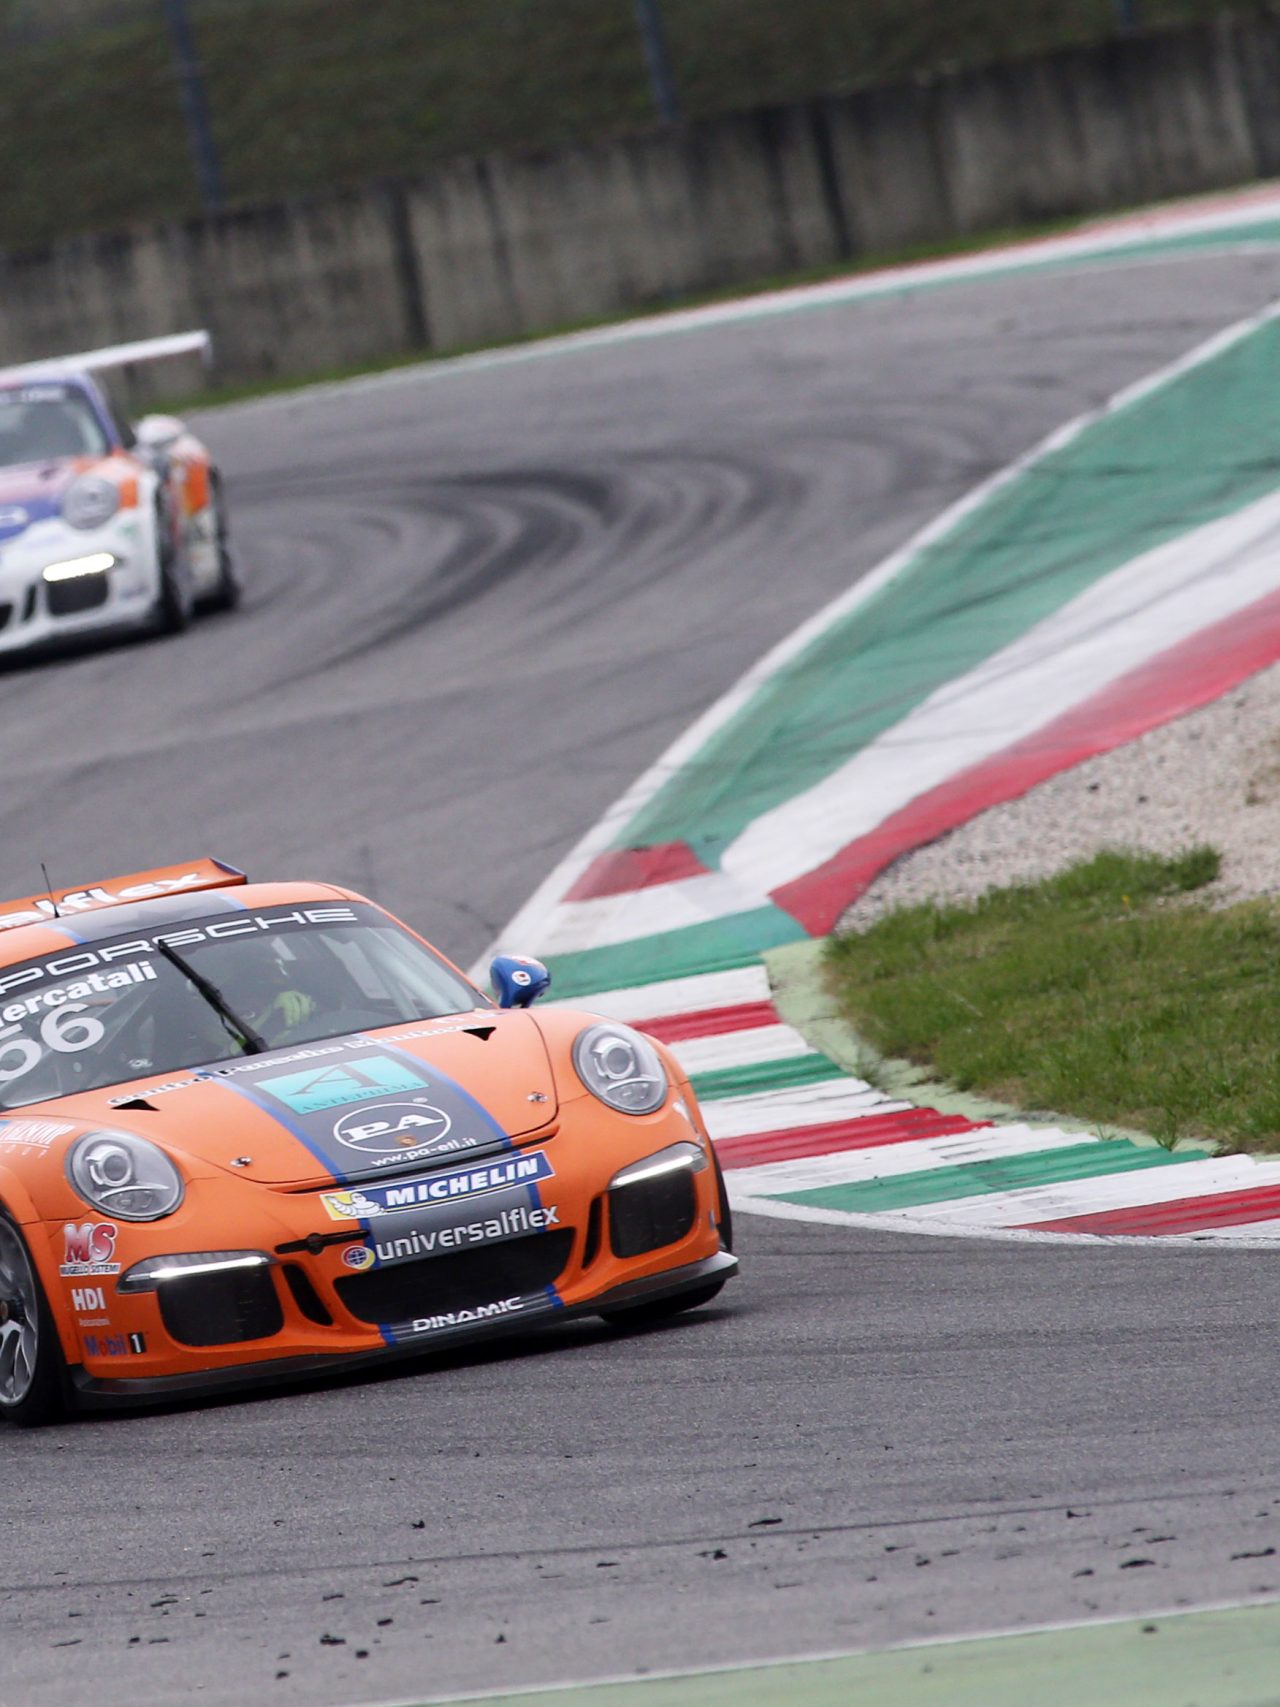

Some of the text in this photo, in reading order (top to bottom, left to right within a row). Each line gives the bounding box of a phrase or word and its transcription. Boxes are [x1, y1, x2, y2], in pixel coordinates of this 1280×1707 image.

[341, 1114, 445, 1143] PA
[386, 1157, 539, 1208] MICHELIN
[63, 1222, 118, 1265] MS
[376, 1205, 561, 1262] universalflex
[71, 1287, 106, 1311] HDI
[412, 1296, 525, 1332] DINAMIC
[131, 1334, 142, 1353] 1
